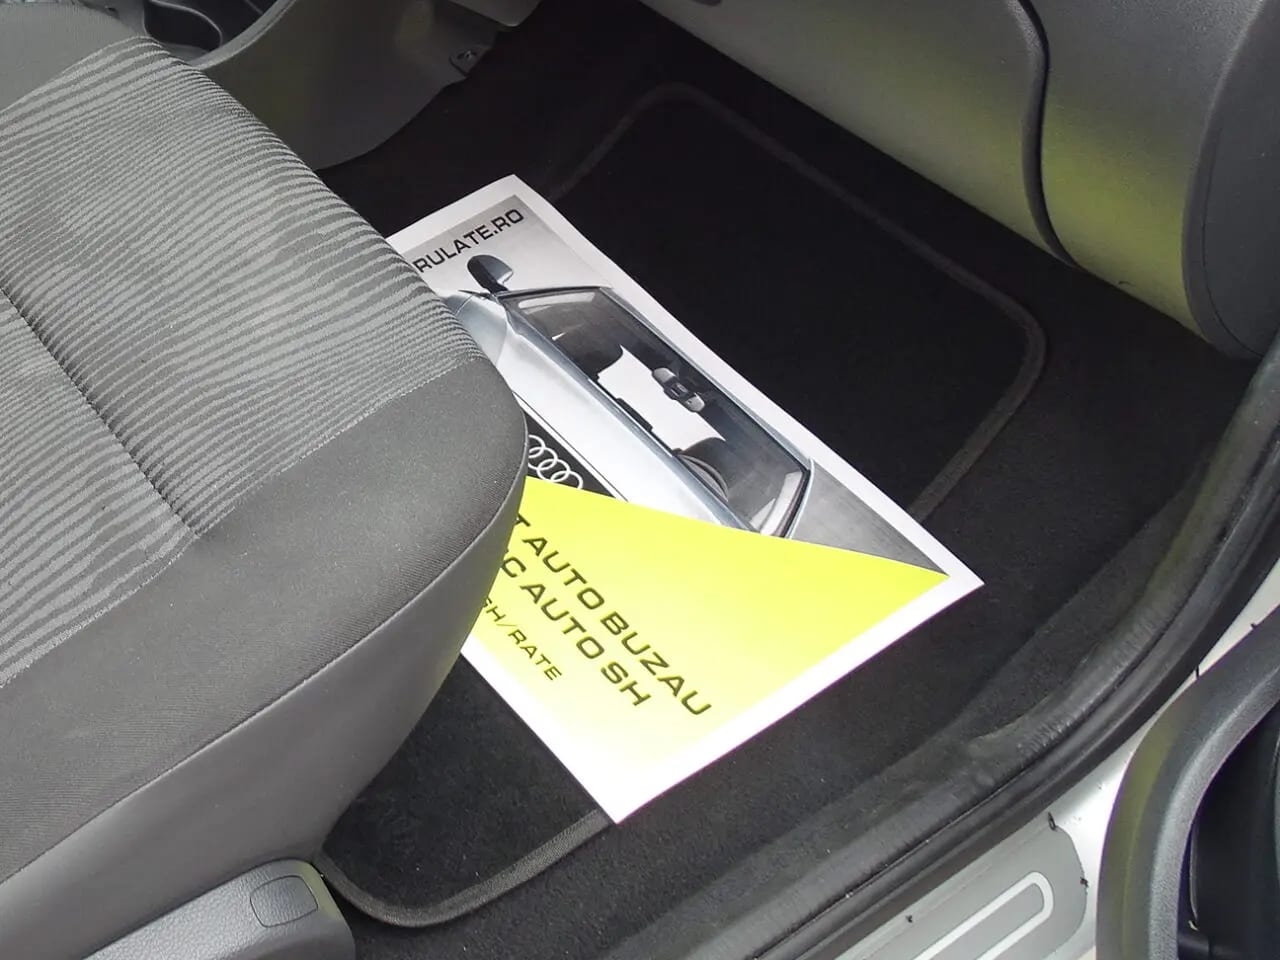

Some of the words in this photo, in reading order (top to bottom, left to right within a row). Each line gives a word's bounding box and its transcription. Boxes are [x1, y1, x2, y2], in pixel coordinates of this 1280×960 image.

[500, 551, 527, 578] C
[520, 583, 605, 660] AUTO
[600, 661, 652, 707] SH
[521, 537, 605, 610] AUTO
[600, 611, 712, 715] BUZAU
